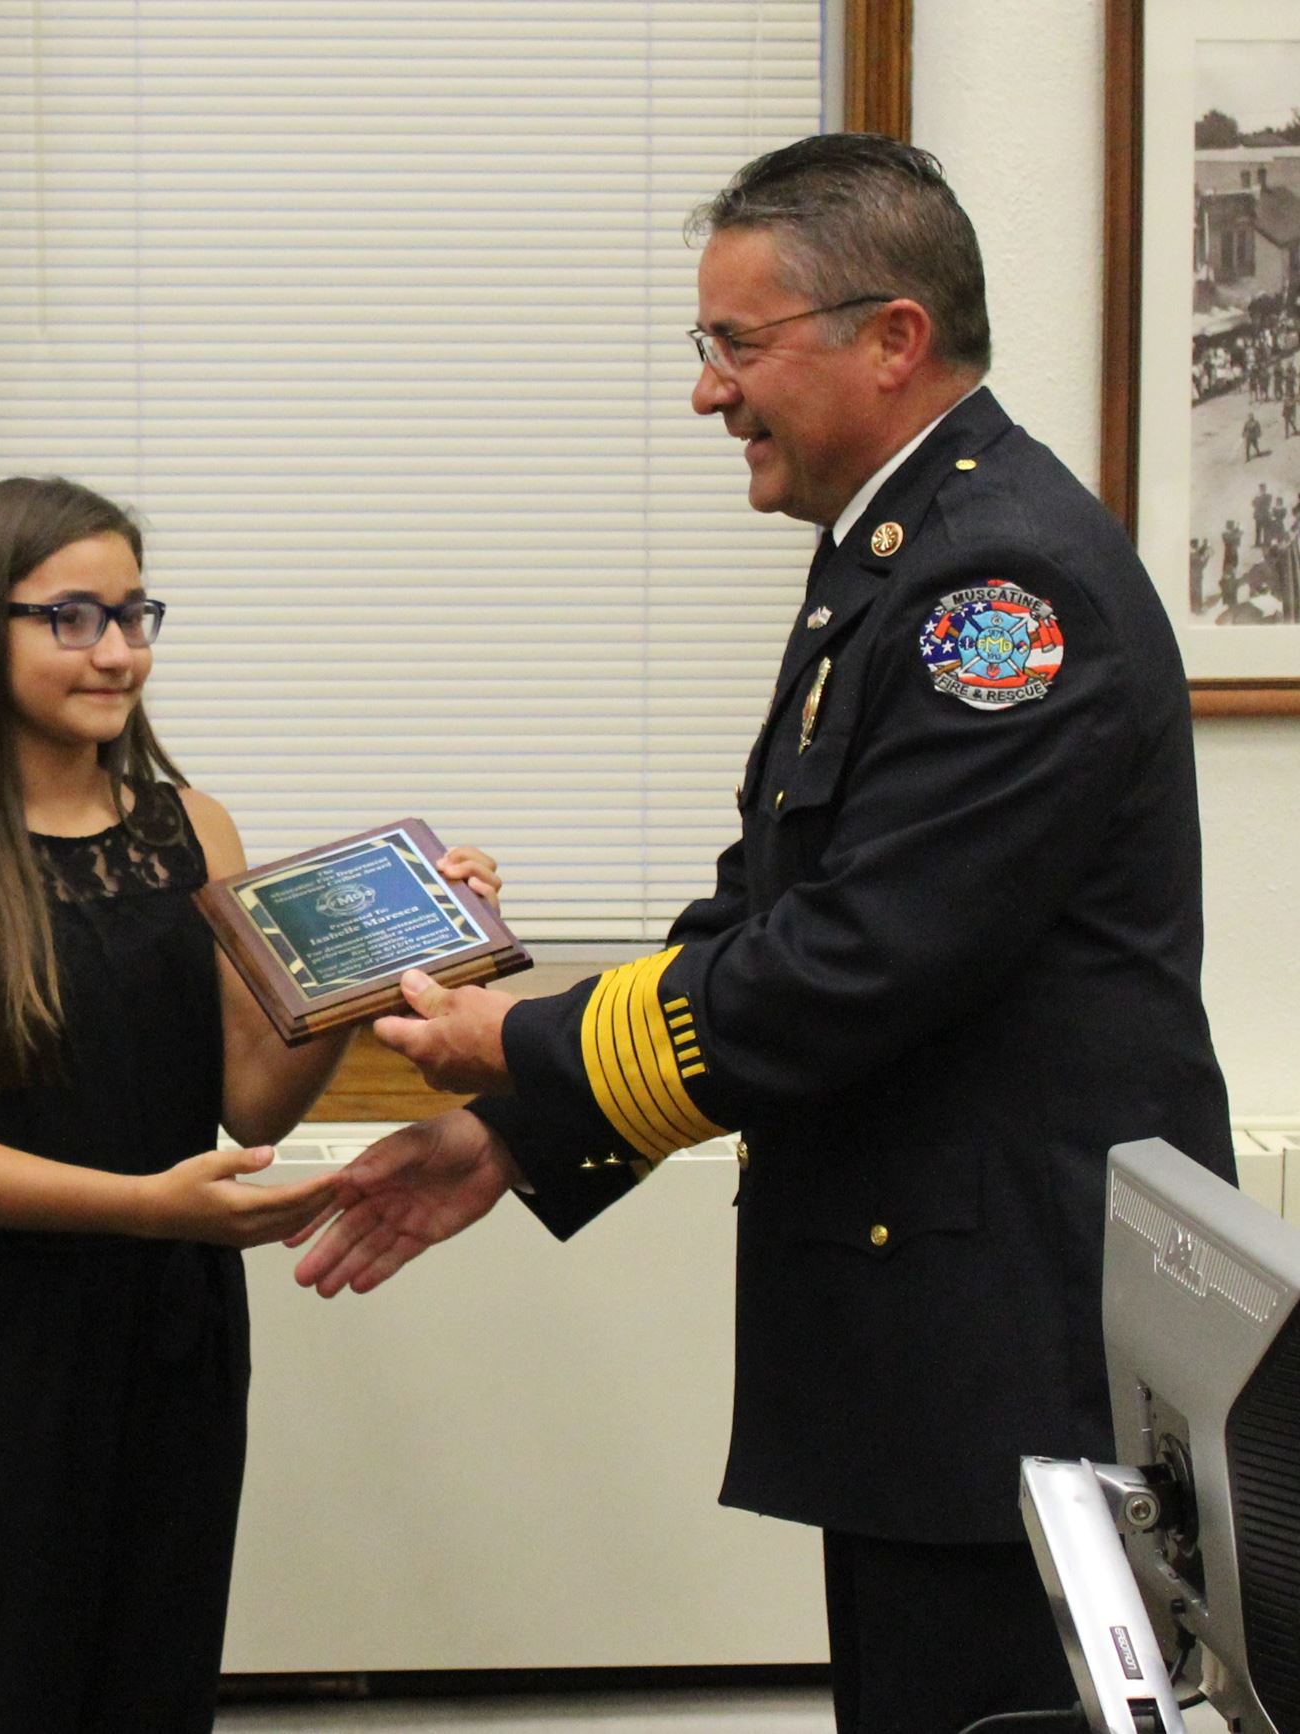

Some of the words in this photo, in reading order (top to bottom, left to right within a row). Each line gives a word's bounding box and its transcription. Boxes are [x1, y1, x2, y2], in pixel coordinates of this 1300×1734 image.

[952, 590, 1044, 611] MUSCATINE
[938, 677, 968, 696] FIRE
[973, 688, 982, 700] &
[986, 684, 1044, 701] RESCUE
[336, 856, 388, 877] Department
[309, 924, 360, 945] Isabelle
[362, 904, 419, 927] Maresca
[329, 912, 372, 929] Presented
[403, 917, 439, 931] stressful
[324, 929, 385, 953] demonstrating
[386, 912, 436, 932] outstanding
